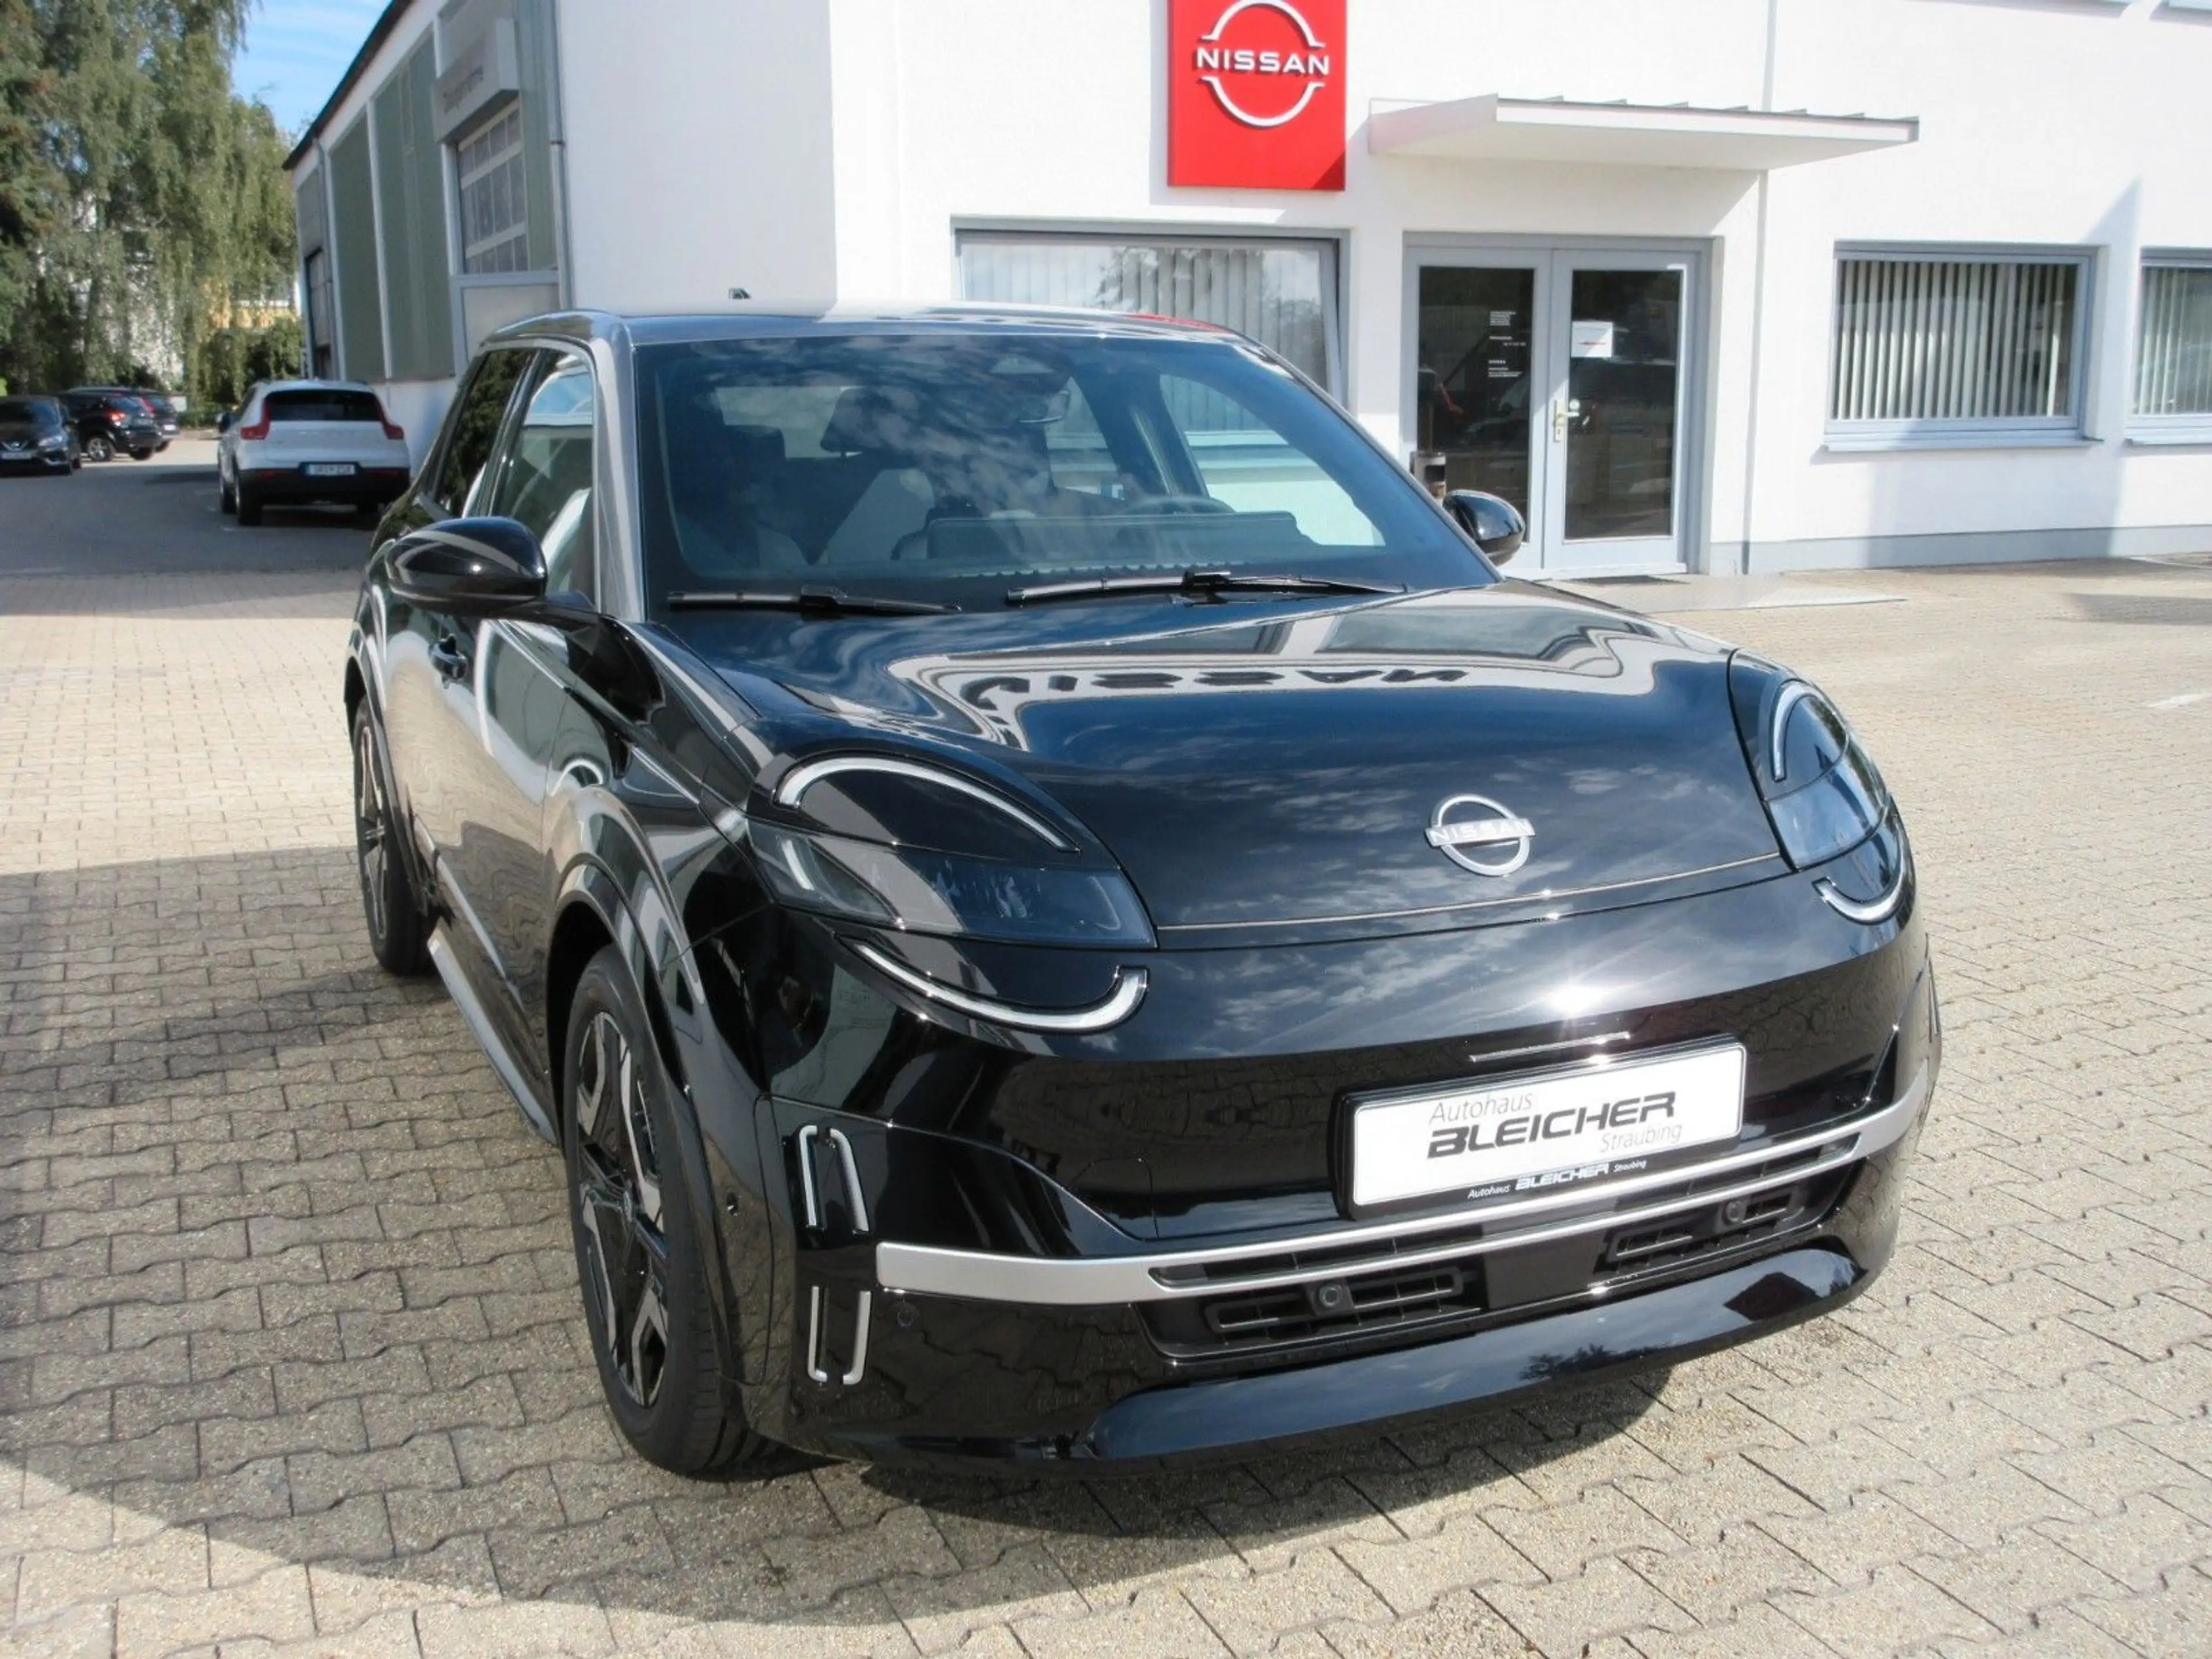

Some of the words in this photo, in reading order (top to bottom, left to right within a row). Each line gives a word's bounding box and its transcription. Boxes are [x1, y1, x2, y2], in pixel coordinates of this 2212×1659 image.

[1197, 47, 1330, 75] NISSAN
[1429, 819, 1535, 843] NISSAN
[1429, 1092, 1533, 1125] Autohaus
[1427, 1090, 1676, 1159] BLEICHER
[1599, 1123, 1682, 1153] Straubing
[1468, 1184, 1510, 1200] Autohaus
[1514, 1161, 1610, 1191] BLEICHER
[1613, 1160, 1647, 1173] Straubing
